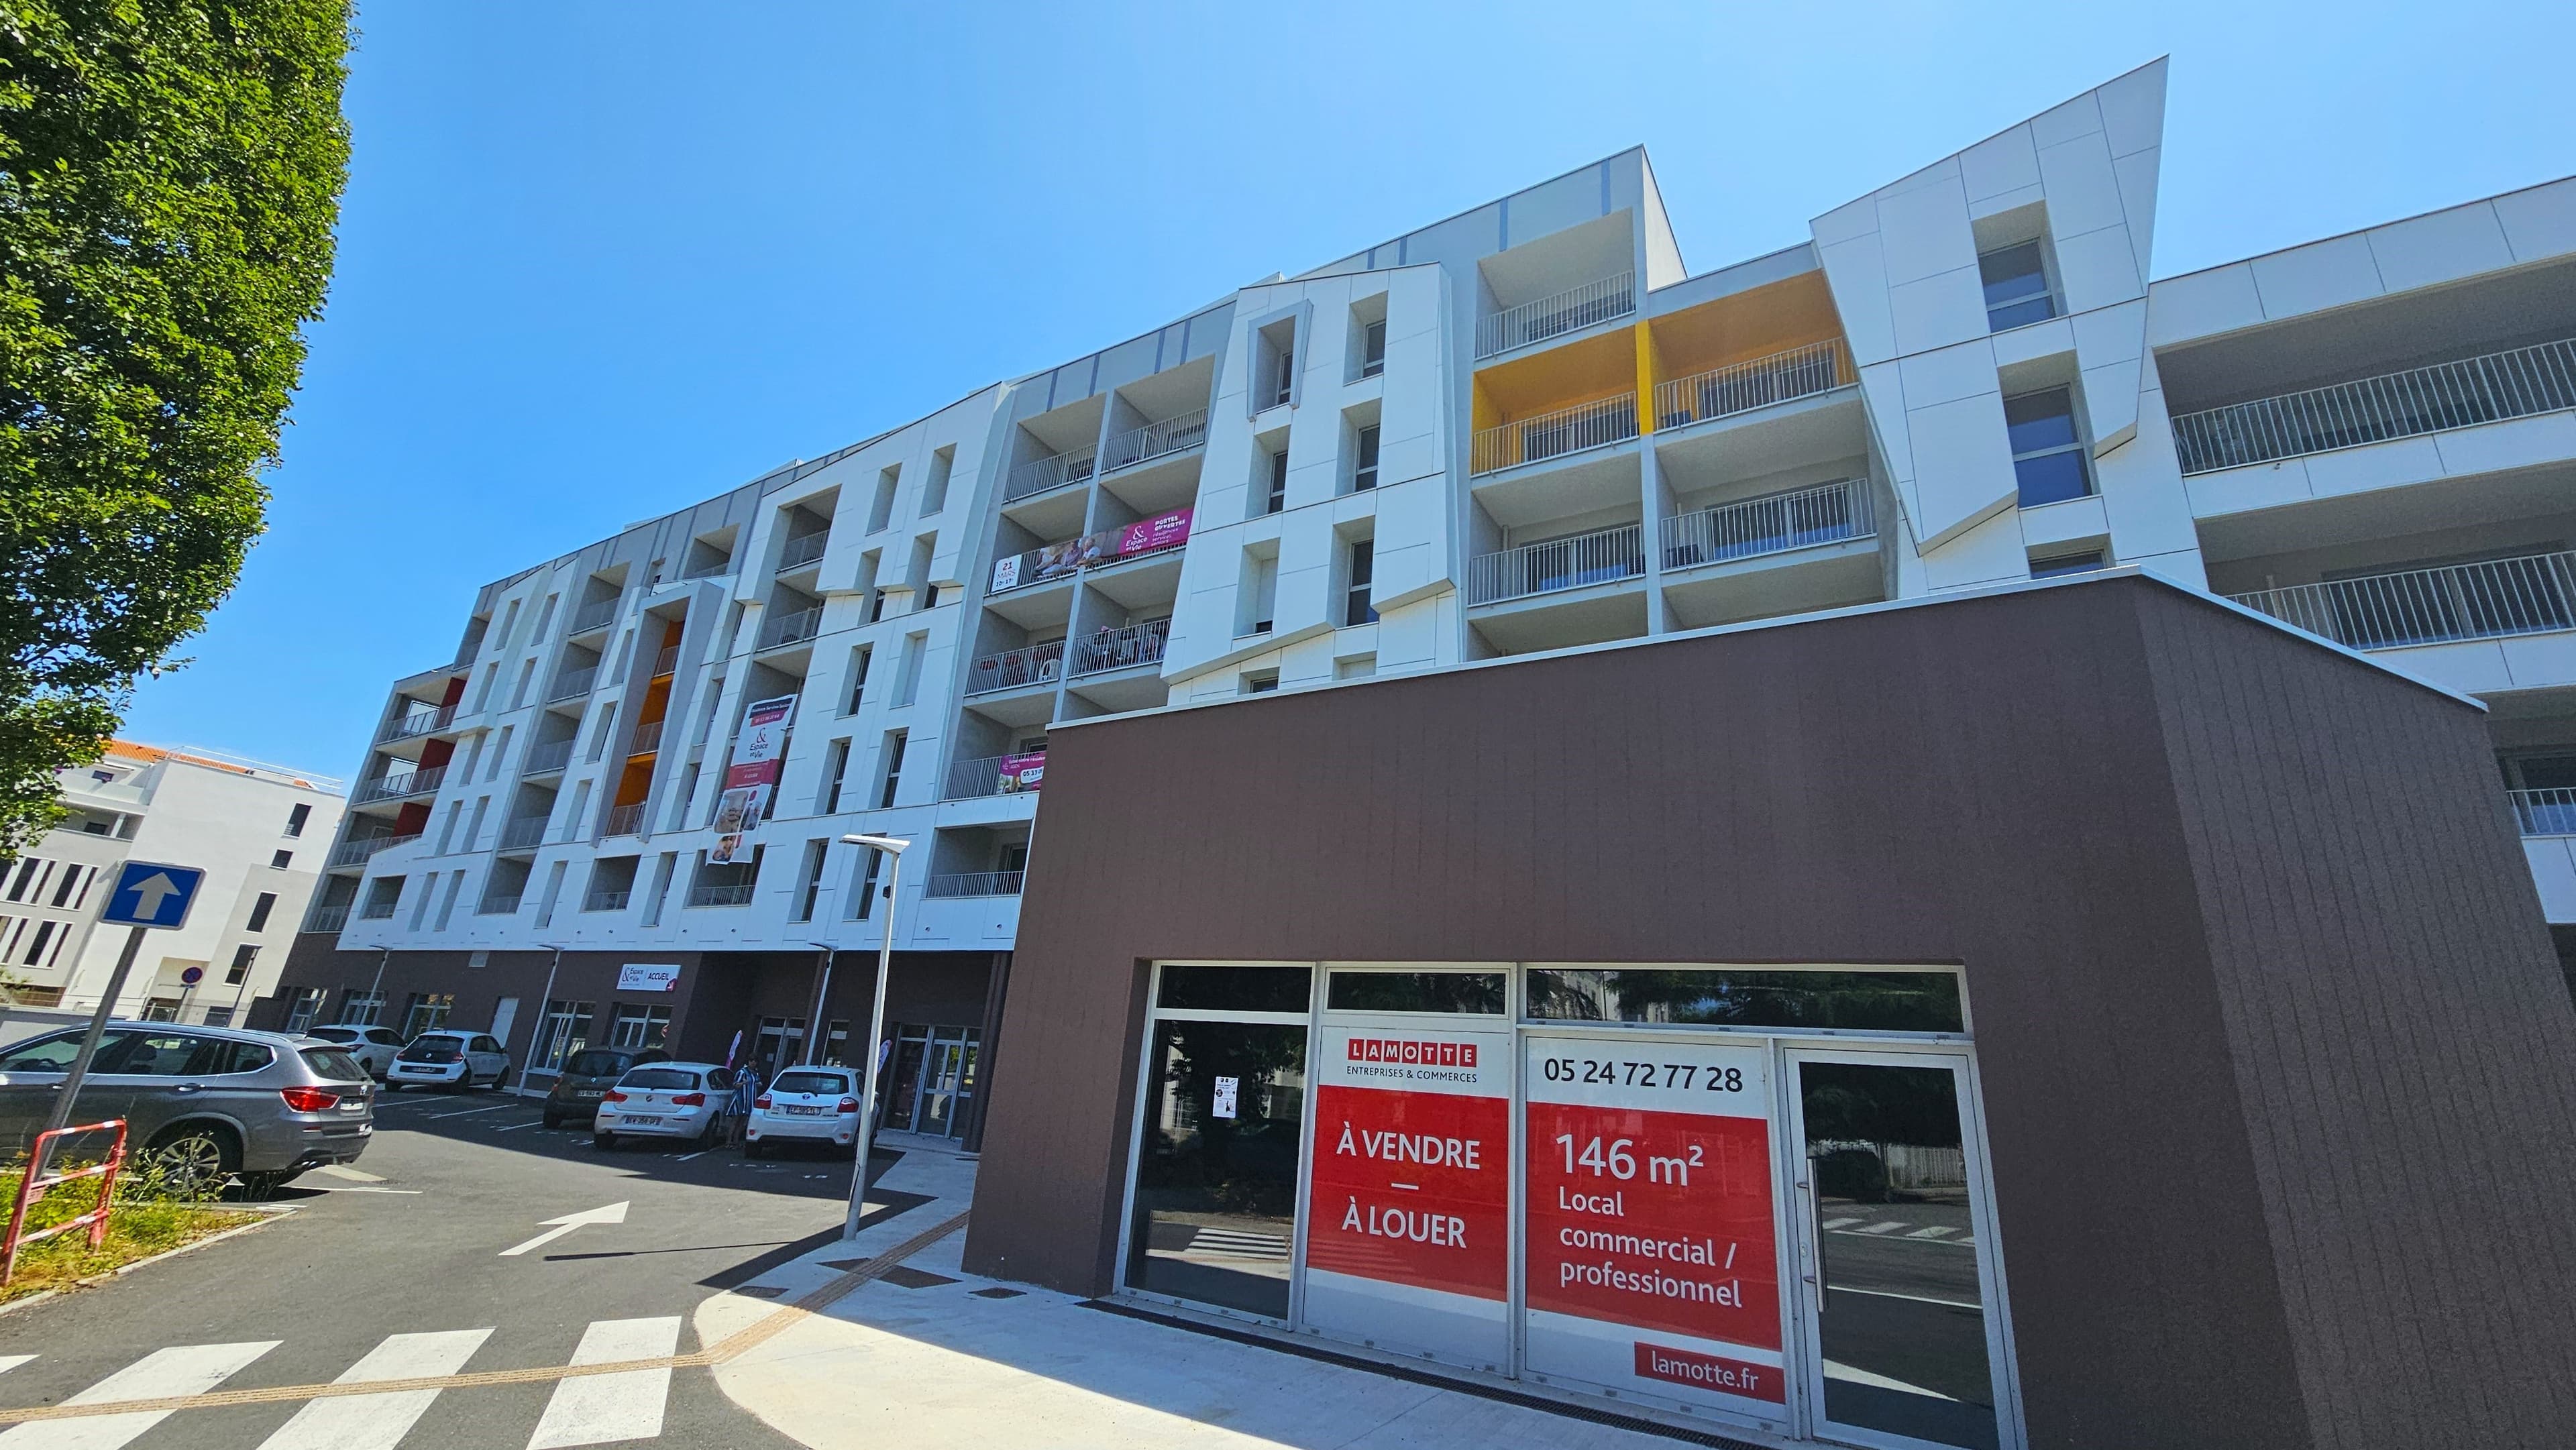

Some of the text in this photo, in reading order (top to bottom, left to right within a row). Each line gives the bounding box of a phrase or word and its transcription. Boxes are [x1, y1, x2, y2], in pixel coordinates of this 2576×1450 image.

[1154, 519, 1185, 531] OUVERTES
[1155, 515, 1179, 526] PORTES
[1126, 537, 1148, 547] Espace
[1002, 561, 1013, 571] 21
[647, 972, 669, 981] ACCUEIL
[1350, 1042, 1474, 1064] LAMOTTE
[1346, 1066, 1477, 1082] ENTREPRISES & COMMERCES
[1544, 1058, 1743, 1093] 05 24 72 77 28
[1336, 1121, 1481, 1170] À VENDRE
[1556, 1133, 1704, 1186] 146 m²
[1559, 1186, 1624, 1217] Local
[1342, 1196, 1466, 1248] À LOUER
[1560, 1227, 1716, 1266] commercial
[1560, 1262, 1742, 1308] professionnel
[1652, 1350, 1759, 1391] lamotte.fr
